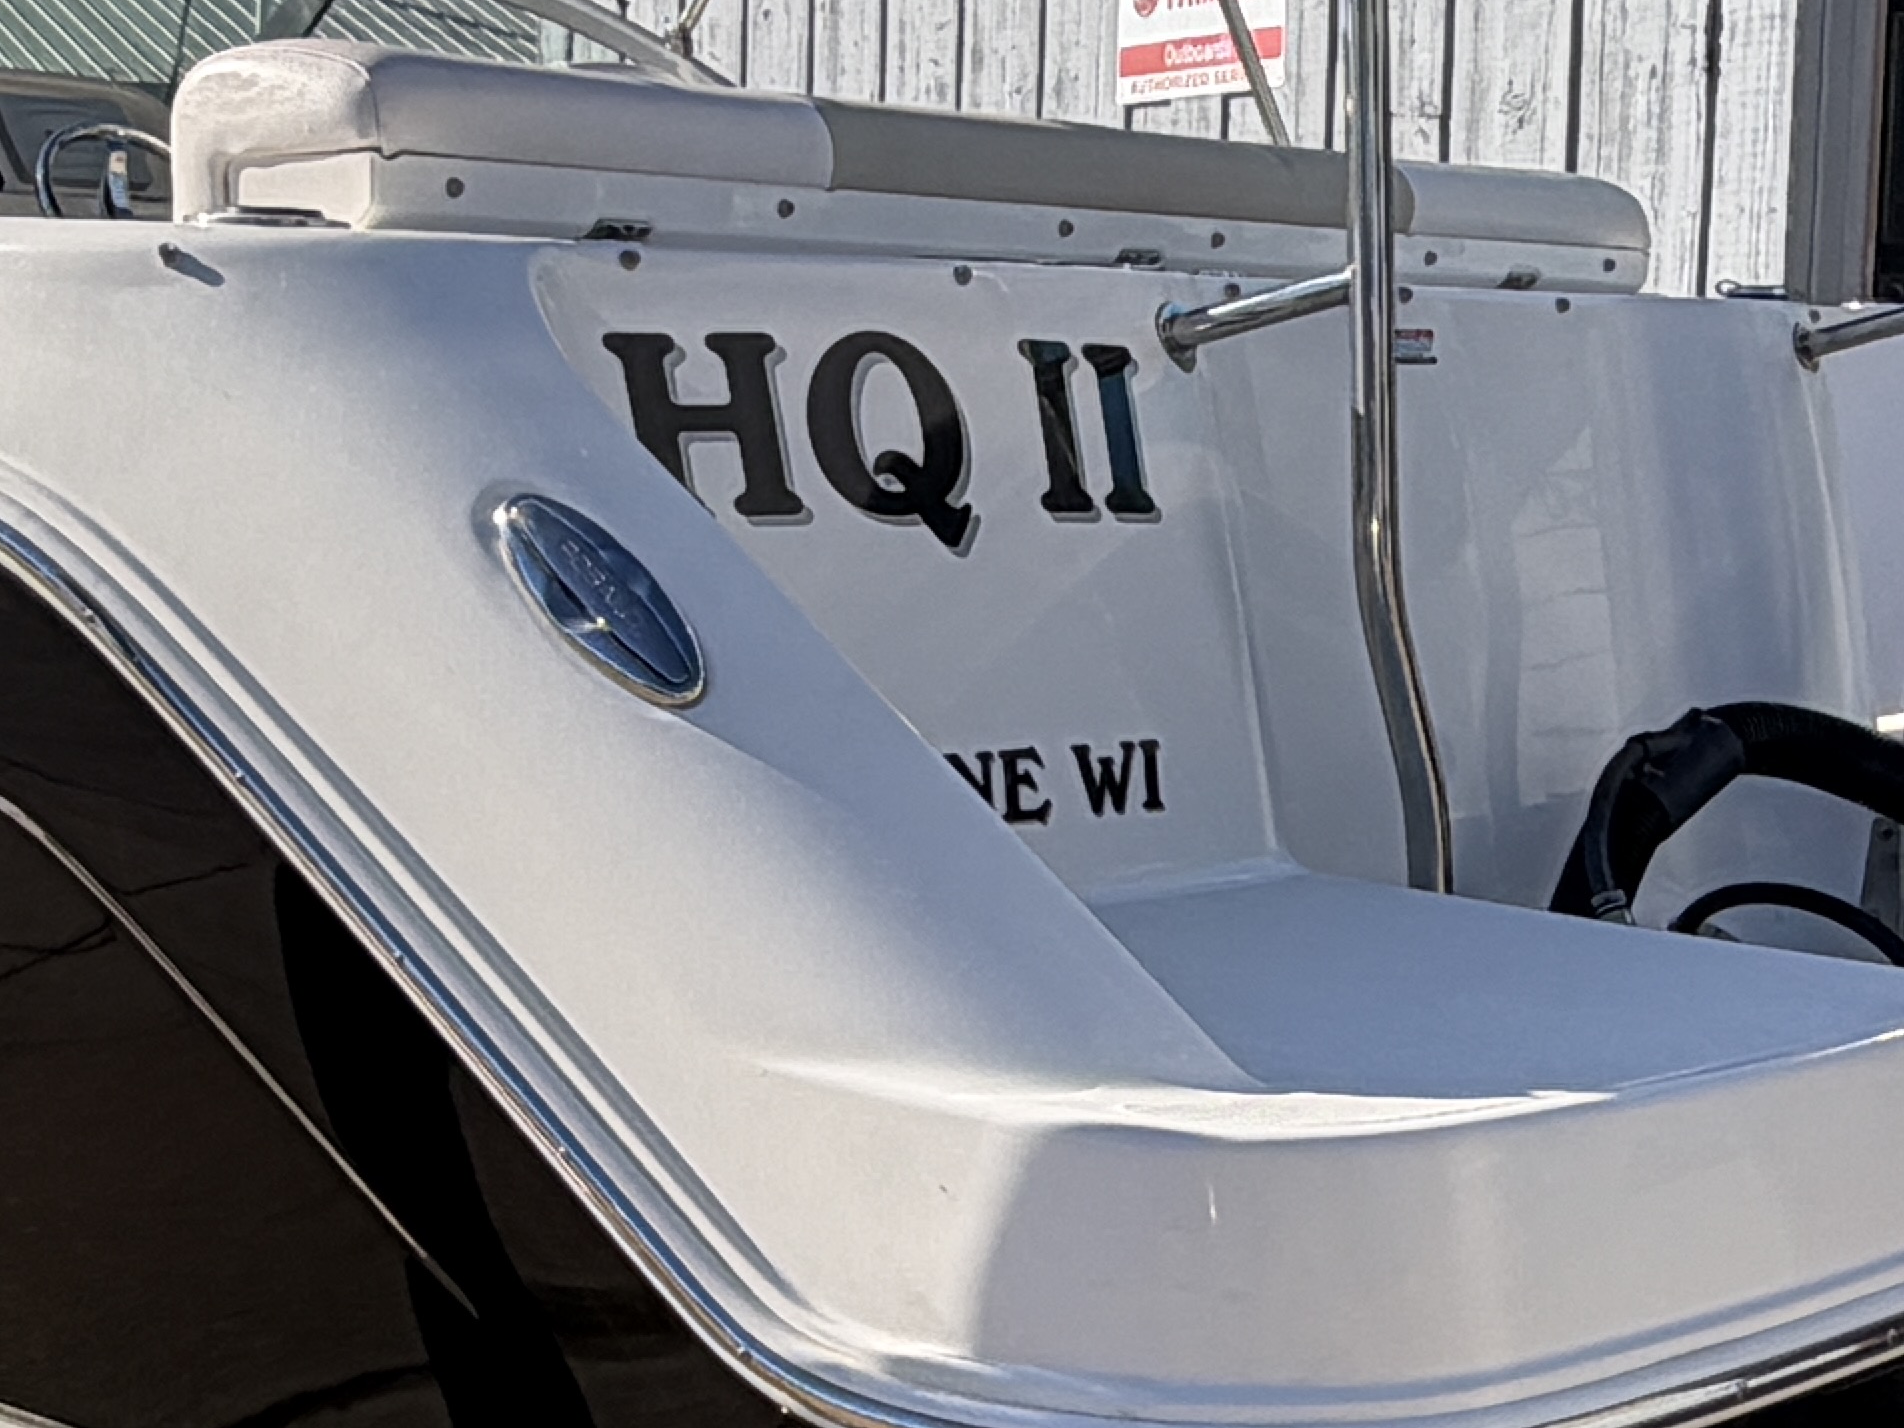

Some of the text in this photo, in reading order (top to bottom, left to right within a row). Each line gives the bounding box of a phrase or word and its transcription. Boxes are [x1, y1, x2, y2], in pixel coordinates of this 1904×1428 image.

[601, 329, 1161, 557] HQ II
[1070, 738, 1165, 817] WI
